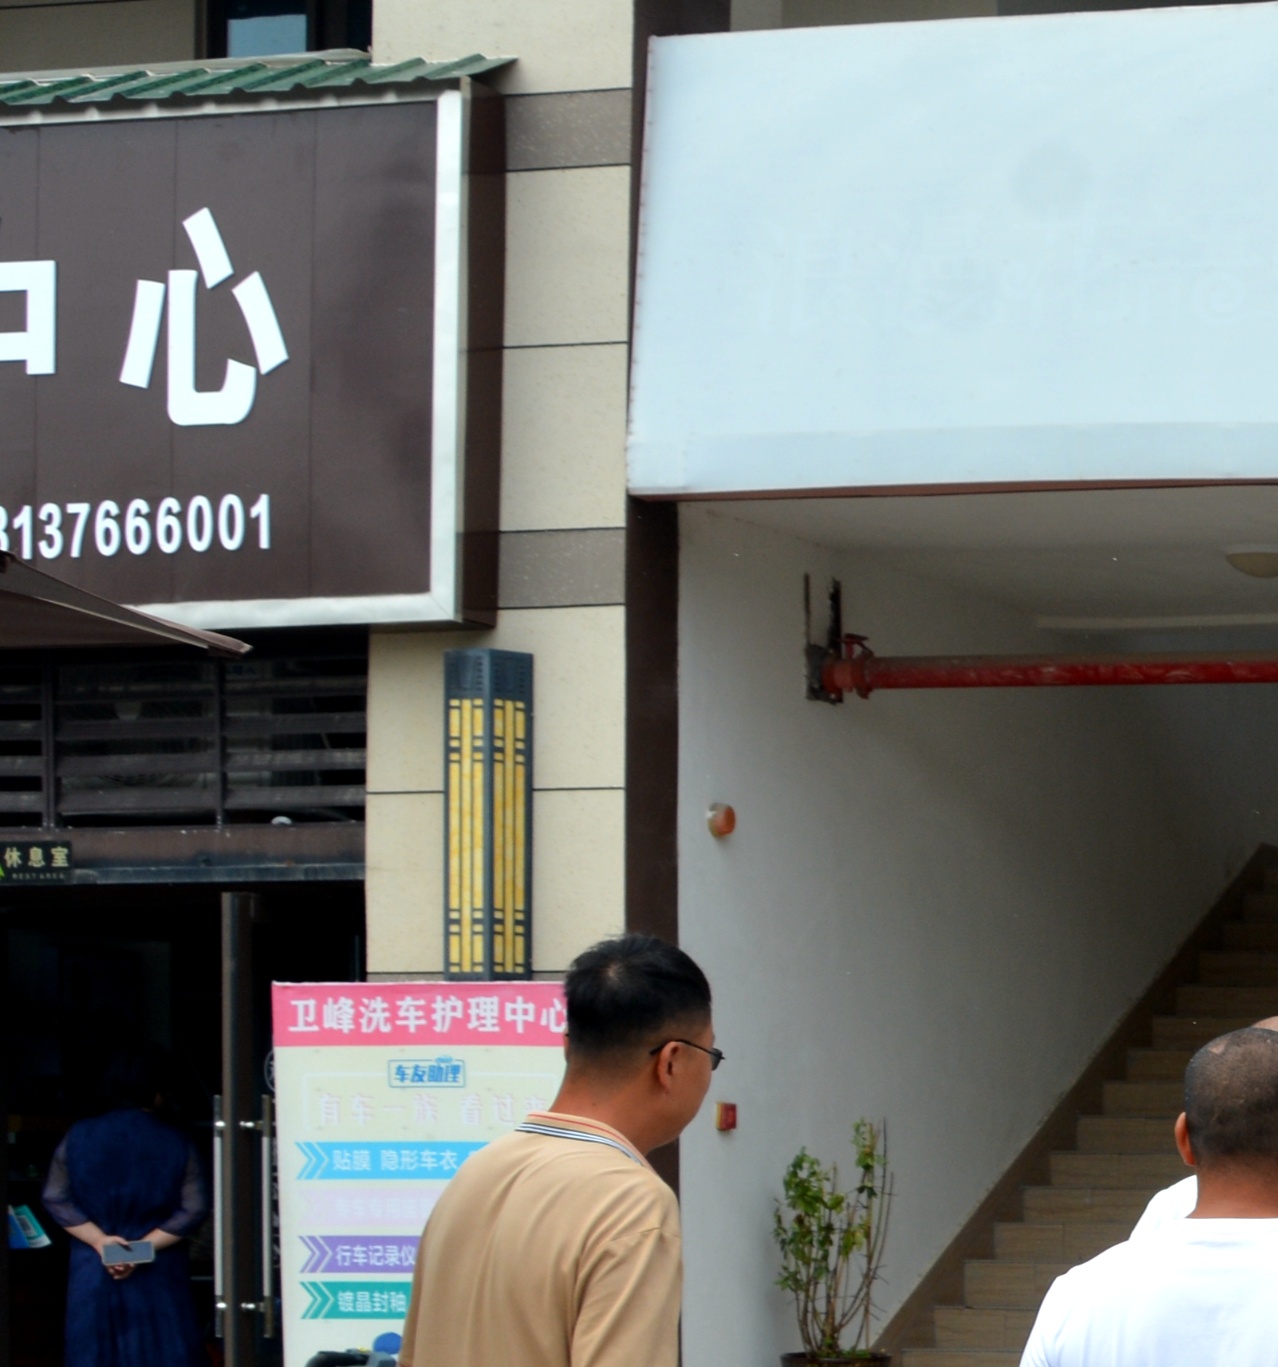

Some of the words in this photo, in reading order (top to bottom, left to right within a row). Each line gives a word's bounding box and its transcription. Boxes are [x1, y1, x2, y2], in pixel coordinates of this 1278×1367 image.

[4, 846, 69, 868] 休息室
[288, 995, 568, 1035] 卫峰洗车护理中心
